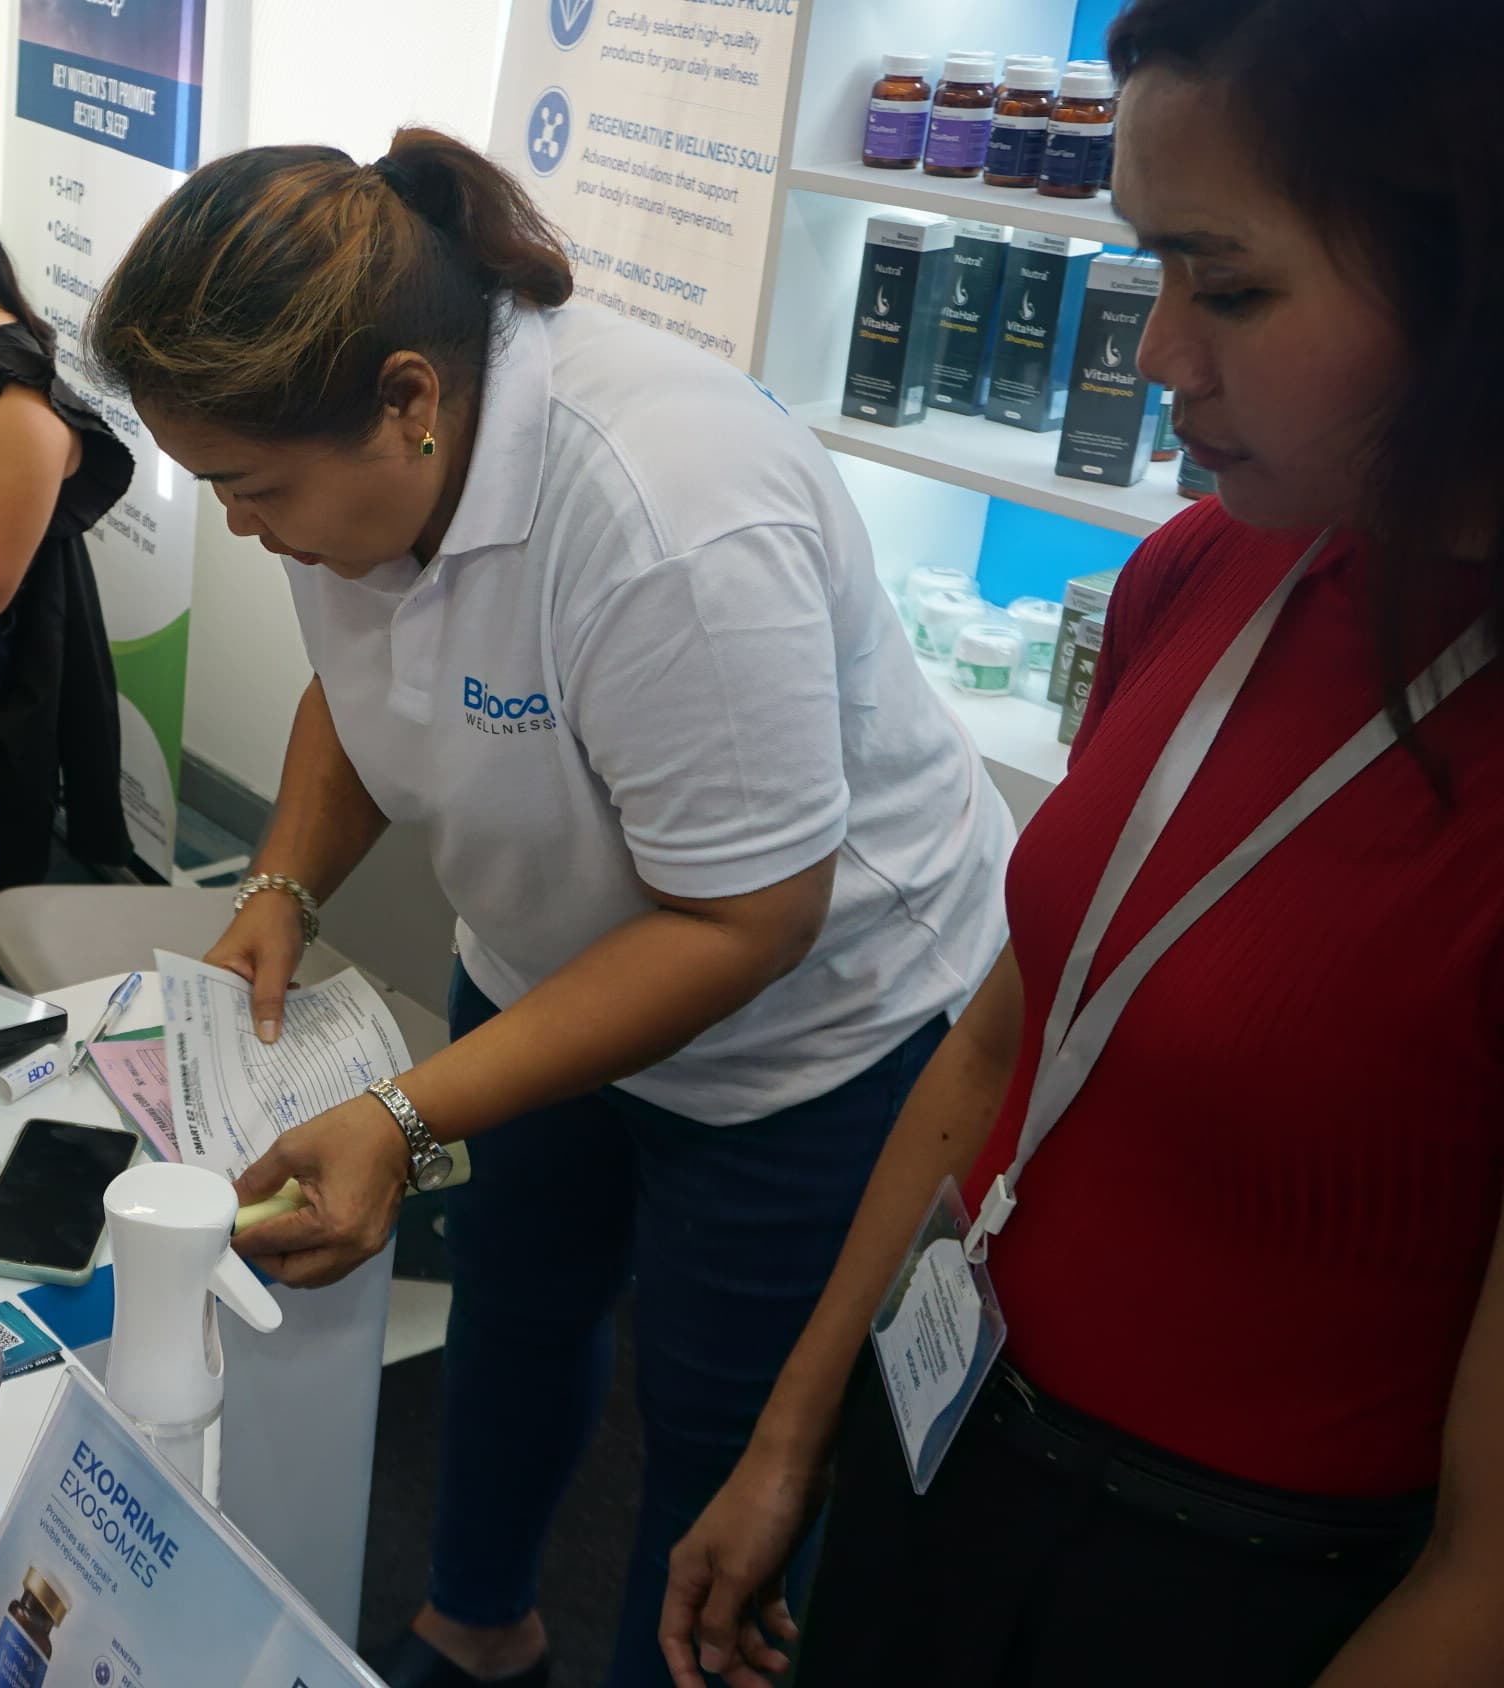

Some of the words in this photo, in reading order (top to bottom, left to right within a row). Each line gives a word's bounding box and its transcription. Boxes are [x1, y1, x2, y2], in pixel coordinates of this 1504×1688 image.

[607, 9, 651, 37] Carefully
[653, 17, 696, 41] selected
[697, 23, 761, 55] high-quality
[600, 43, 645, 65] products
[647, 48, 661, 67] for
[662, 56, 686, 73] your
[688, 55, 712, 81] daily
[714, 62, 760, 87] wellness.
[52, 63, 67, 89] KEY
[67, 66, 107, 102] NUTRIENTS
[108, 78, 119, 104] TO
[119, 81, 157, 116] PROMOTE
[73, 100, 105, 133] RESTFUL
[105, 110, 130, 140] SLEEP
[588, 113, 674, 150] REGENERATIVE
[675, 133, 738, 167] WELLNESS
[738, 152, 779, 175] SOLU
[56, 175, 85, 204] 5-HTP
[581, 147, 630, 173] Advanced
[631, 160, 673, 185] solutions
[673, 170, 696, 191] that
[697, 181, 739, 204] support
[575, 178, 598, 195] your
[599, 180, 630, 207] body's
[632, 194, 666, 216] natural
[54, 220, 92, 256] Calcium
[52, 264, 99, 302] Melatonin
[613, 259, 651, 286] AGING
[652, 271, 707, 307] SUPPORT
[51, 307, 81, 341] Herbal
[665, 315, 686, 336] and
[686, 324, 737, 358] longevity
[861, 316, 902, 333] VitaHair
[1007, 320, 1047, 338] VitaHair
[1102, 311, 1138, 325] Nutra
[1081, 381, 1135, 398] Shampoo
[1083, 367, 1138, 386] VitaHair
[105, 403, 141, 439] extract
[463, 675, 553, 720] Bioco
[464, 711, 554, 736] WELLNESS
[27, 1060, 56, 1085] BDO
[144, 1107, 171, 1132] TRADING
[189, 1124, 206, 1156] SMART
[71, 1439, 180, 1570] EXOPRIME
[45, 1503, 77, 1547] Promotes
[76, 1542, 92, 1562] skin
[90, 1558, 113, 1588] repair
[59, 1469, 158, 1589] EXOSOMES
[39, 1517, 62, 1547] visible
[59, 1542, 103, 1596] rejuvenation
